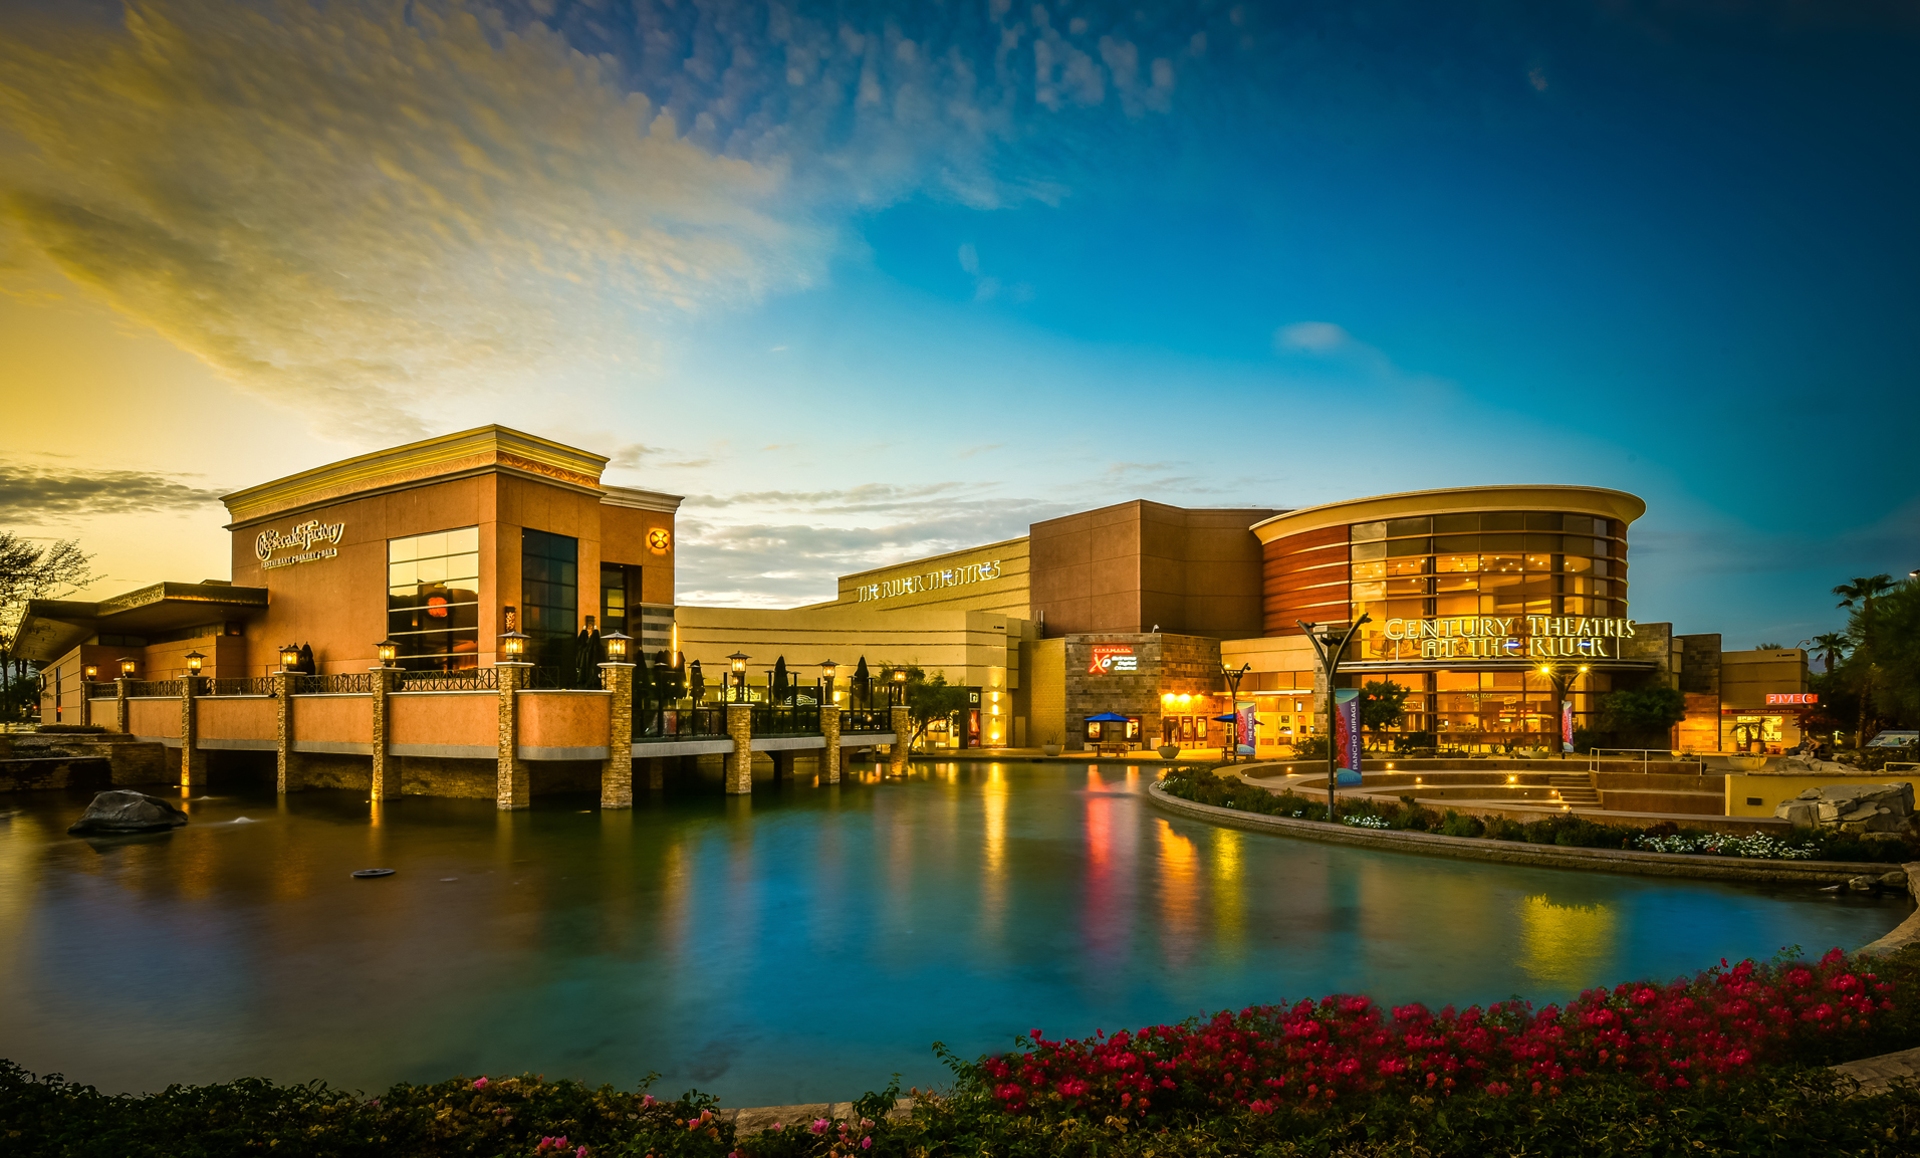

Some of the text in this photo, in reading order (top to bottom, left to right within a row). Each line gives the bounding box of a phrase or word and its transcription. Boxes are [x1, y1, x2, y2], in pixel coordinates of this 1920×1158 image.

[255, 520, 345, 562] Cheesecake Factory
[857, 584, 880, 602] THE
[927, 560, 1001, 590] THEATRES
[1384, 615, 1636, 641] CENTURY THEATRES
[1421, 637, 1457, 658] AT
[1469, 637, 1521, 657] THE
